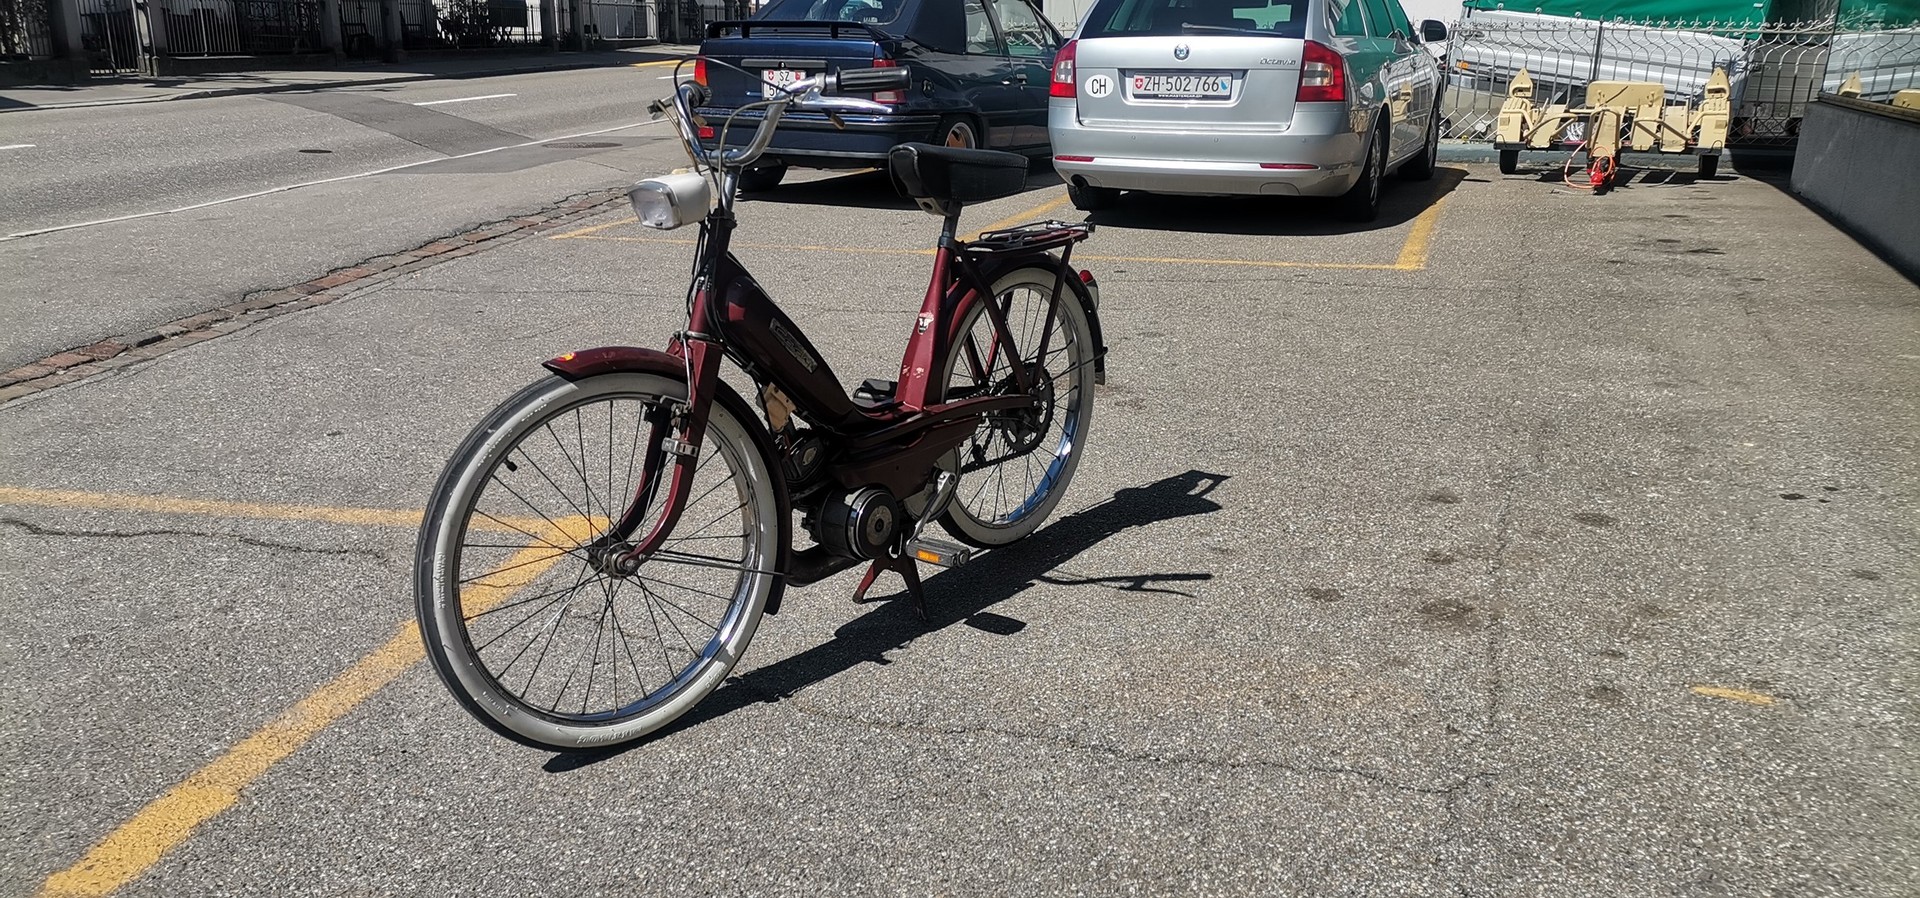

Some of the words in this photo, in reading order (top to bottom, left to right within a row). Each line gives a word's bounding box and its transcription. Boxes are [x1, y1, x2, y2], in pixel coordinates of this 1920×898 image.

[1260, 57, 1297, 66] Octavia
[779, 71, 790, 82] SZ
[1091, 78, 1107, 95] CH
